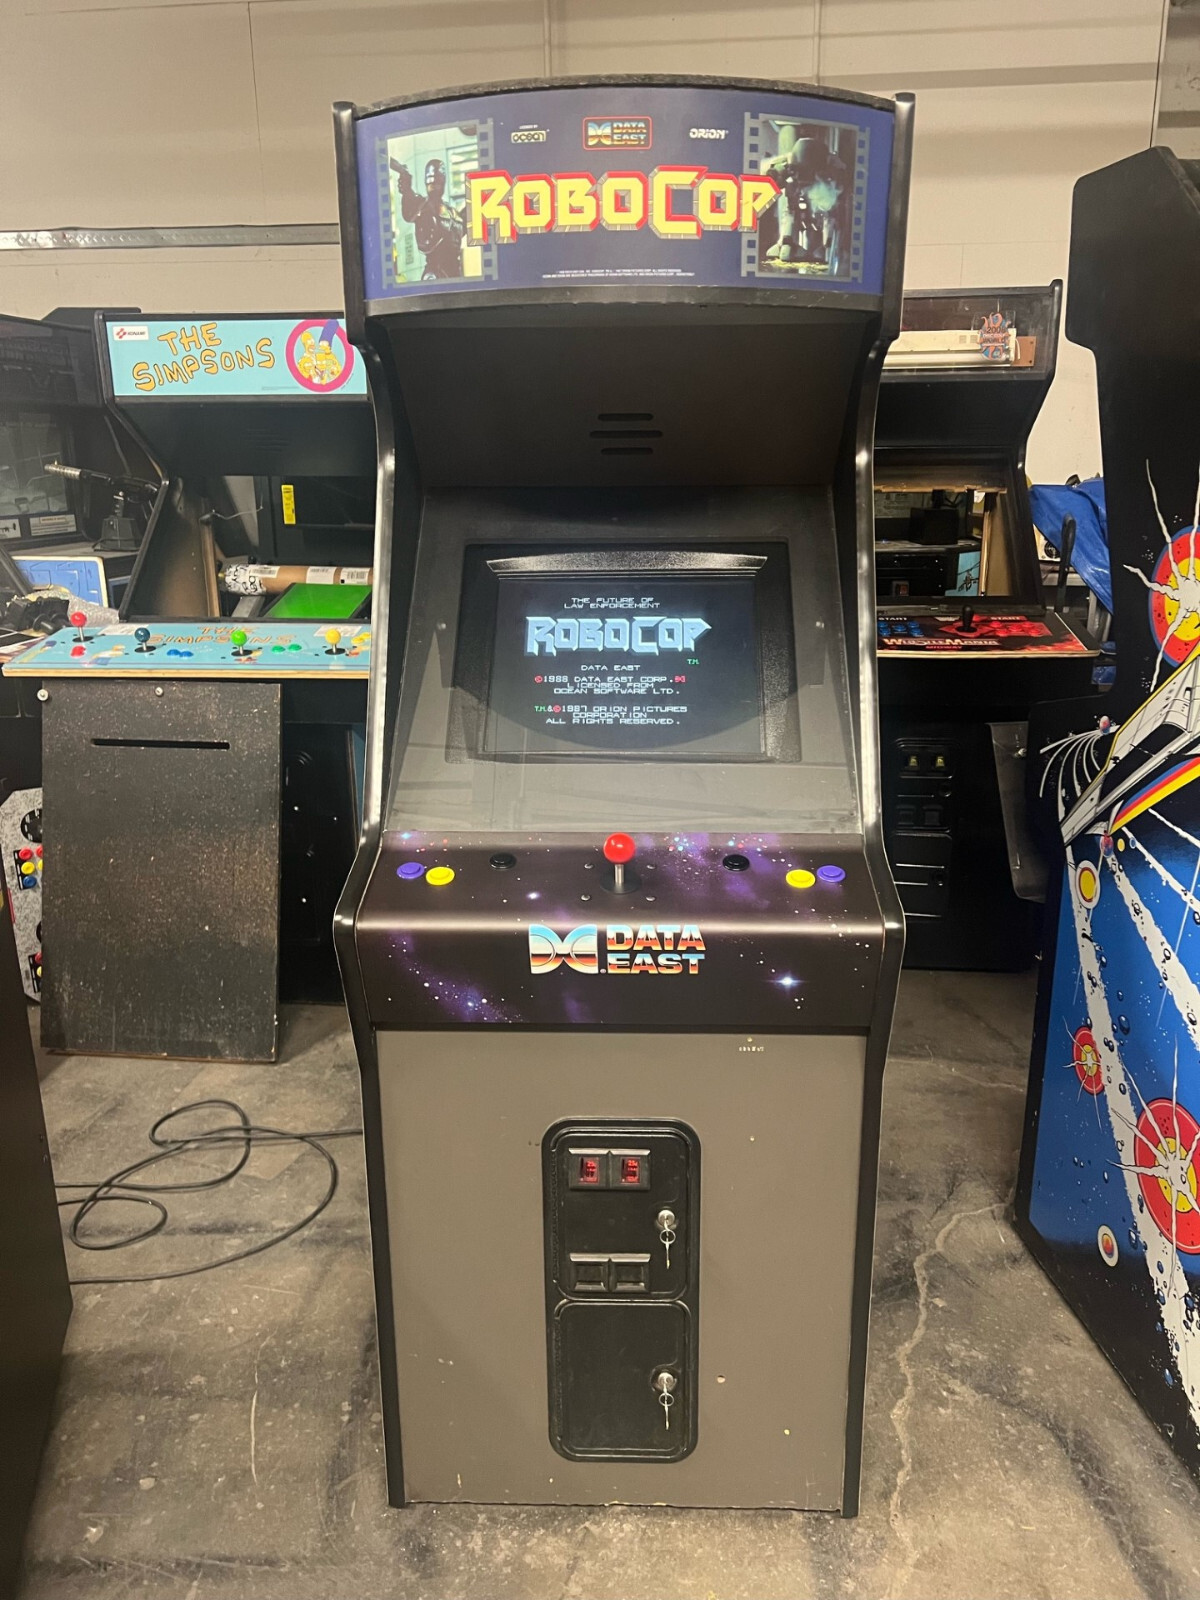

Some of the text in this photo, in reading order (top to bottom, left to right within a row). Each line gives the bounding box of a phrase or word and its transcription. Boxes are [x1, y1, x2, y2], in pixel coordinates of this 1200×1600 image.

[613, 122, 646, 133] DATA
[613, 134, 647, 144] EAST
[465, 164, 783, 246] ROBOCOP
[157, 322, 222, 356] THE
[132, 338, 276, 391] SIMPSONS
[146, 634, 296, 645] SIMPSNS
[525, 616, 712, 656] ROBOCOP
[606, 924, 706, 951] DATA
[607, 953, 705, 974] EAST
